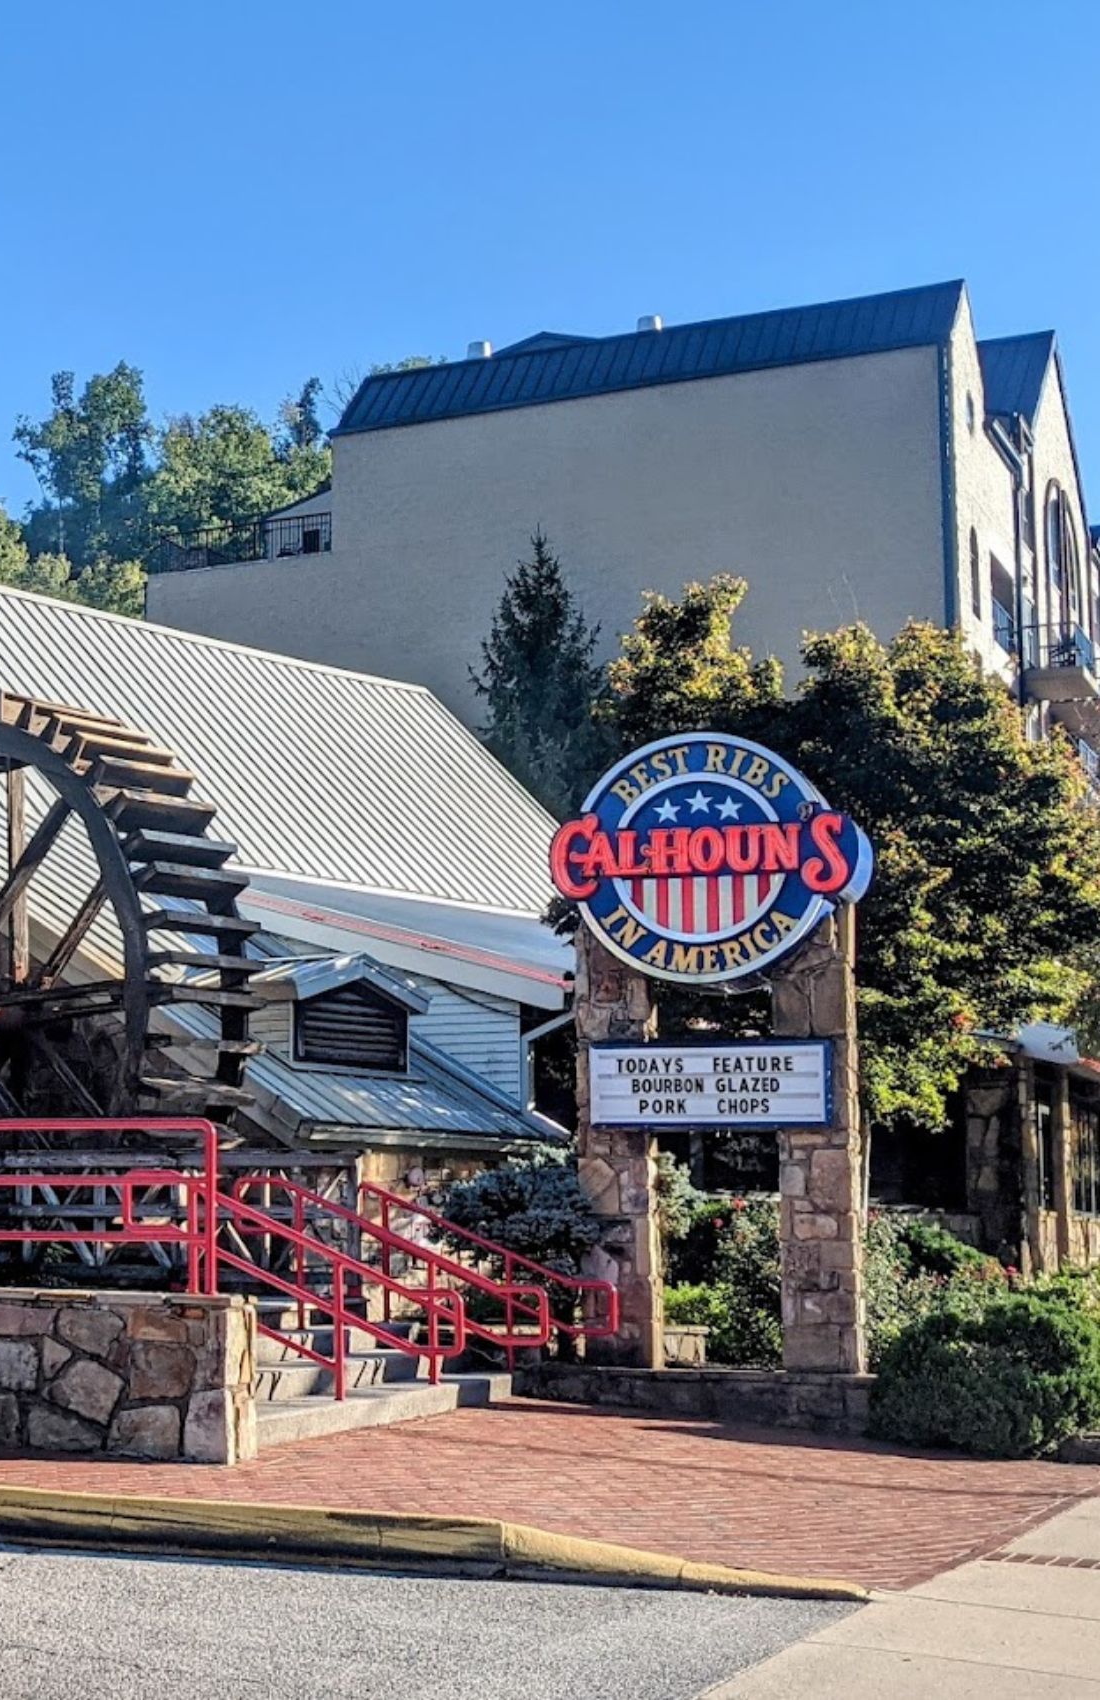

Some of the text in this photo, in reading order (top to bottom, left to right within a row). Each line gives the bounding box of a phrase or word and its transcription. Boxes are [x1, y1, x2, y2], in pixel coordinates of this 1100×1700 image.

[611, 744, 789, 805] BEST RIBS
[551, 801, 849, 898] CALHOUN'S
[601, 904, 799, 973] IN AMERICA
[617, 1056, 793, 1073] TODAYS FEATURE
[632, 1077, 780, 1094] BOURBON GLAZED
[639, 1098, 770, 1114] PORK CHOPS
